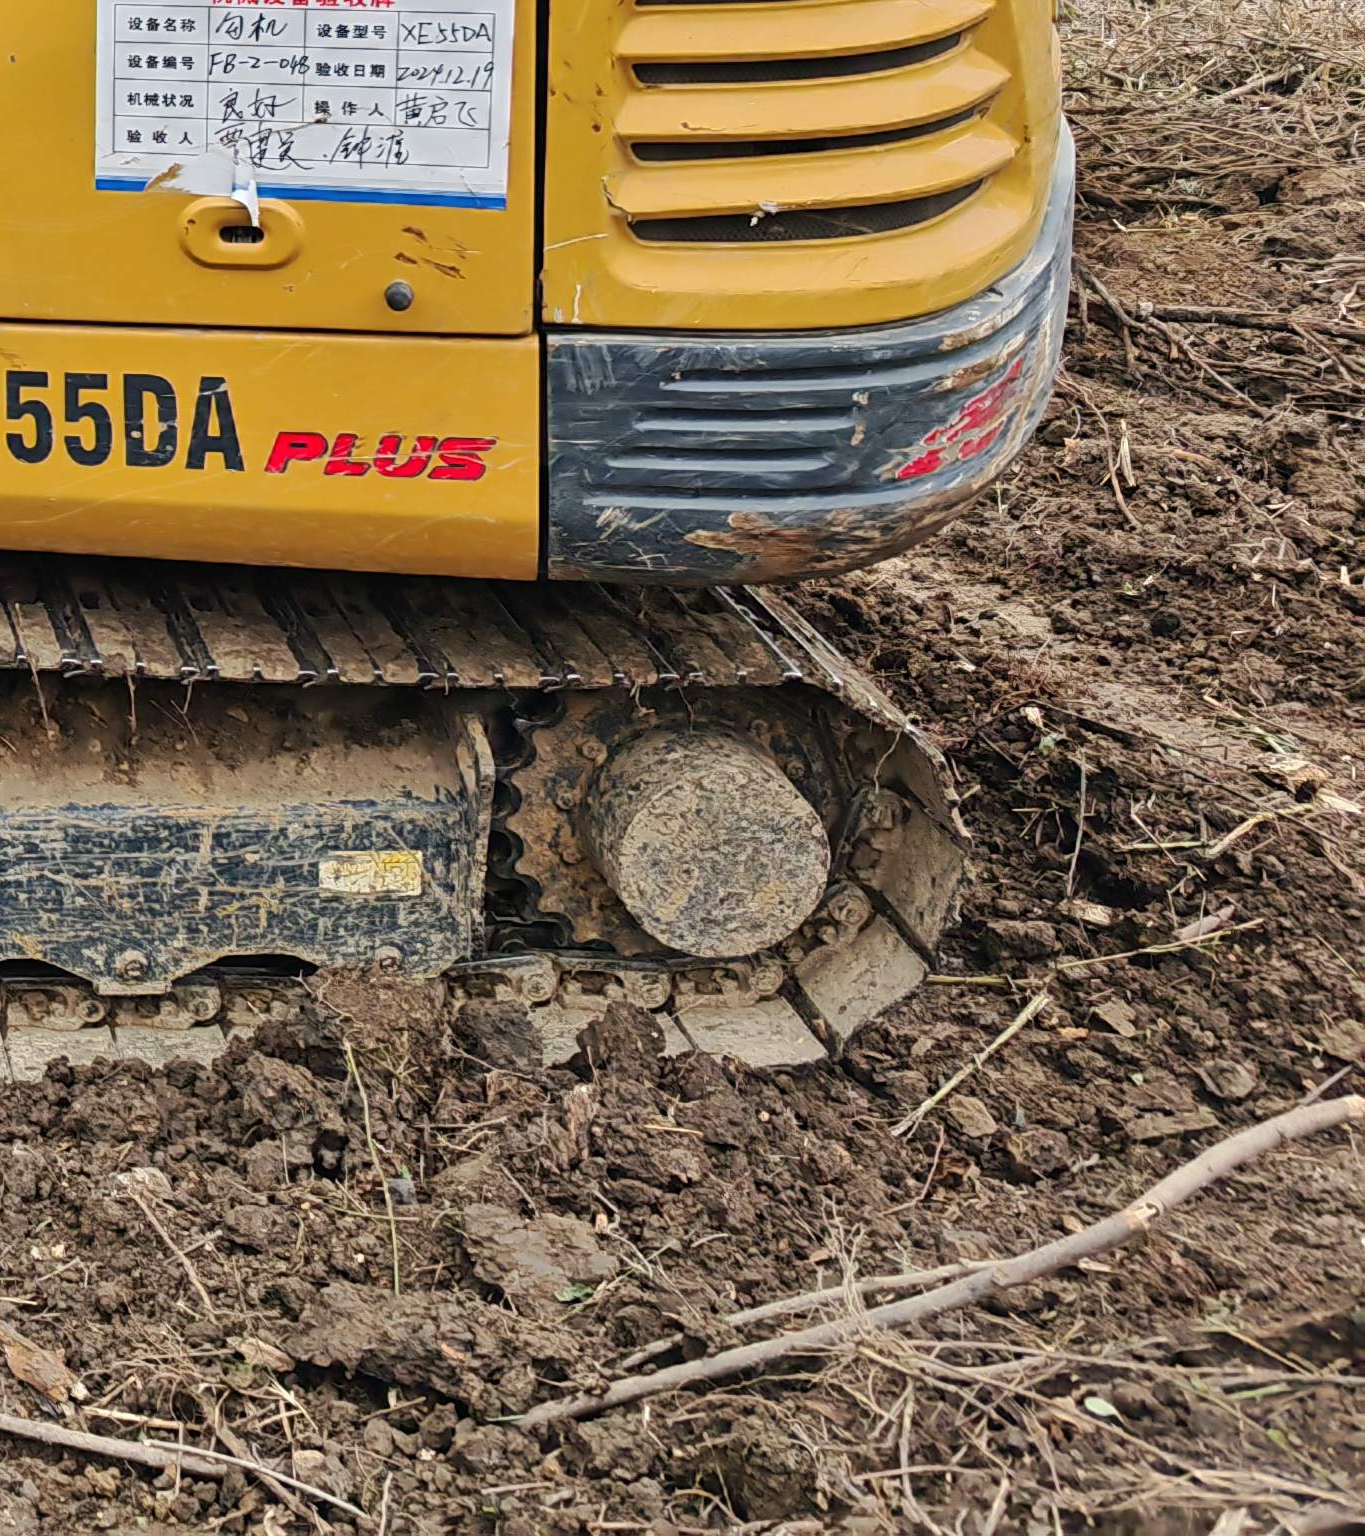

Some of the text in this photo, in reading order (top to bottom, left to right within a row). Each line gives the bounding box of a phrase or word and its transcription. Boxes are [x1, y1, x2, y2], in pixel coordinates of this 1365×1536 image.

[127, 17, 197, 33] 设备名称
[316, 23, 387, 40] 设备型号
[400, 22, 492, 45] XE55DA
[127, 54, 196, 71] 设备编号
[315, 62, 387, 79] 验收日期
[127, 92, 195, 108] 机械状况
[219, 88, 298, 124] 良好
[314, 100, 385, 116] 操作人
[126, 129, 194, 145] 验收人
[264, 430, 498, 482] PLUS
